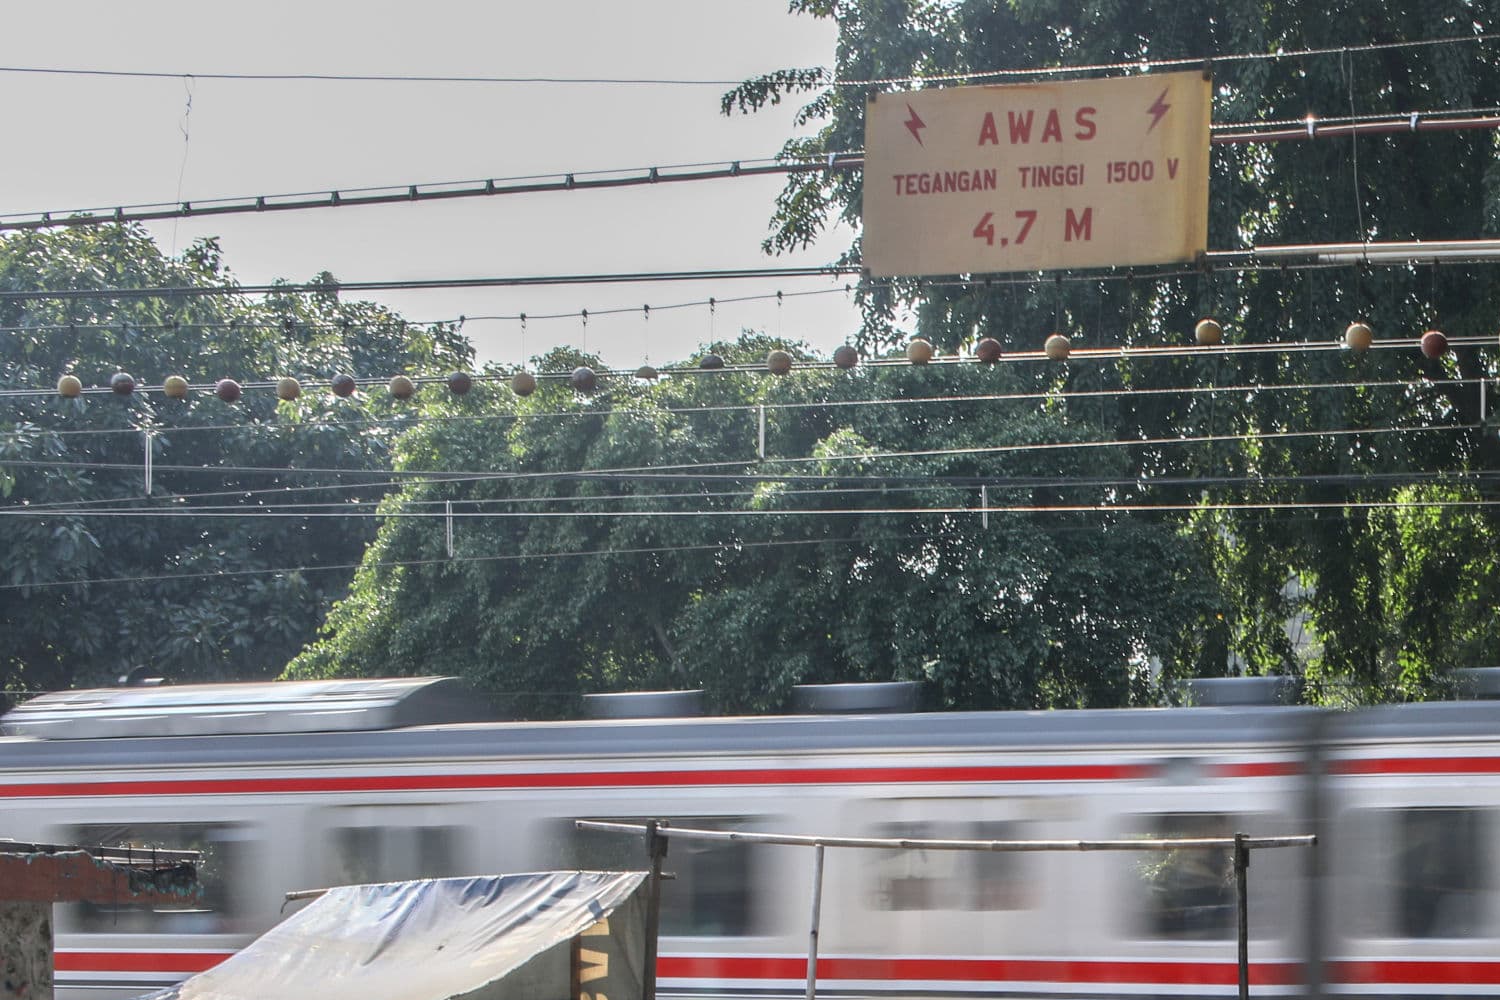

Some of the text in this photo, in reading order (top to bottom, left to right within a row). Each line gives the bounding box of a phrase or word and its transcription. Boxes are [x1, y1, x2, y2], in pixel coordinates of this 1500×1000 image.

[978, 107, 1097, 146] AWAS
[893, 158, 1180, 196] TEGANGAN TINGGI 1500 V
[973, 207, 1093, 247] 4.7 M
